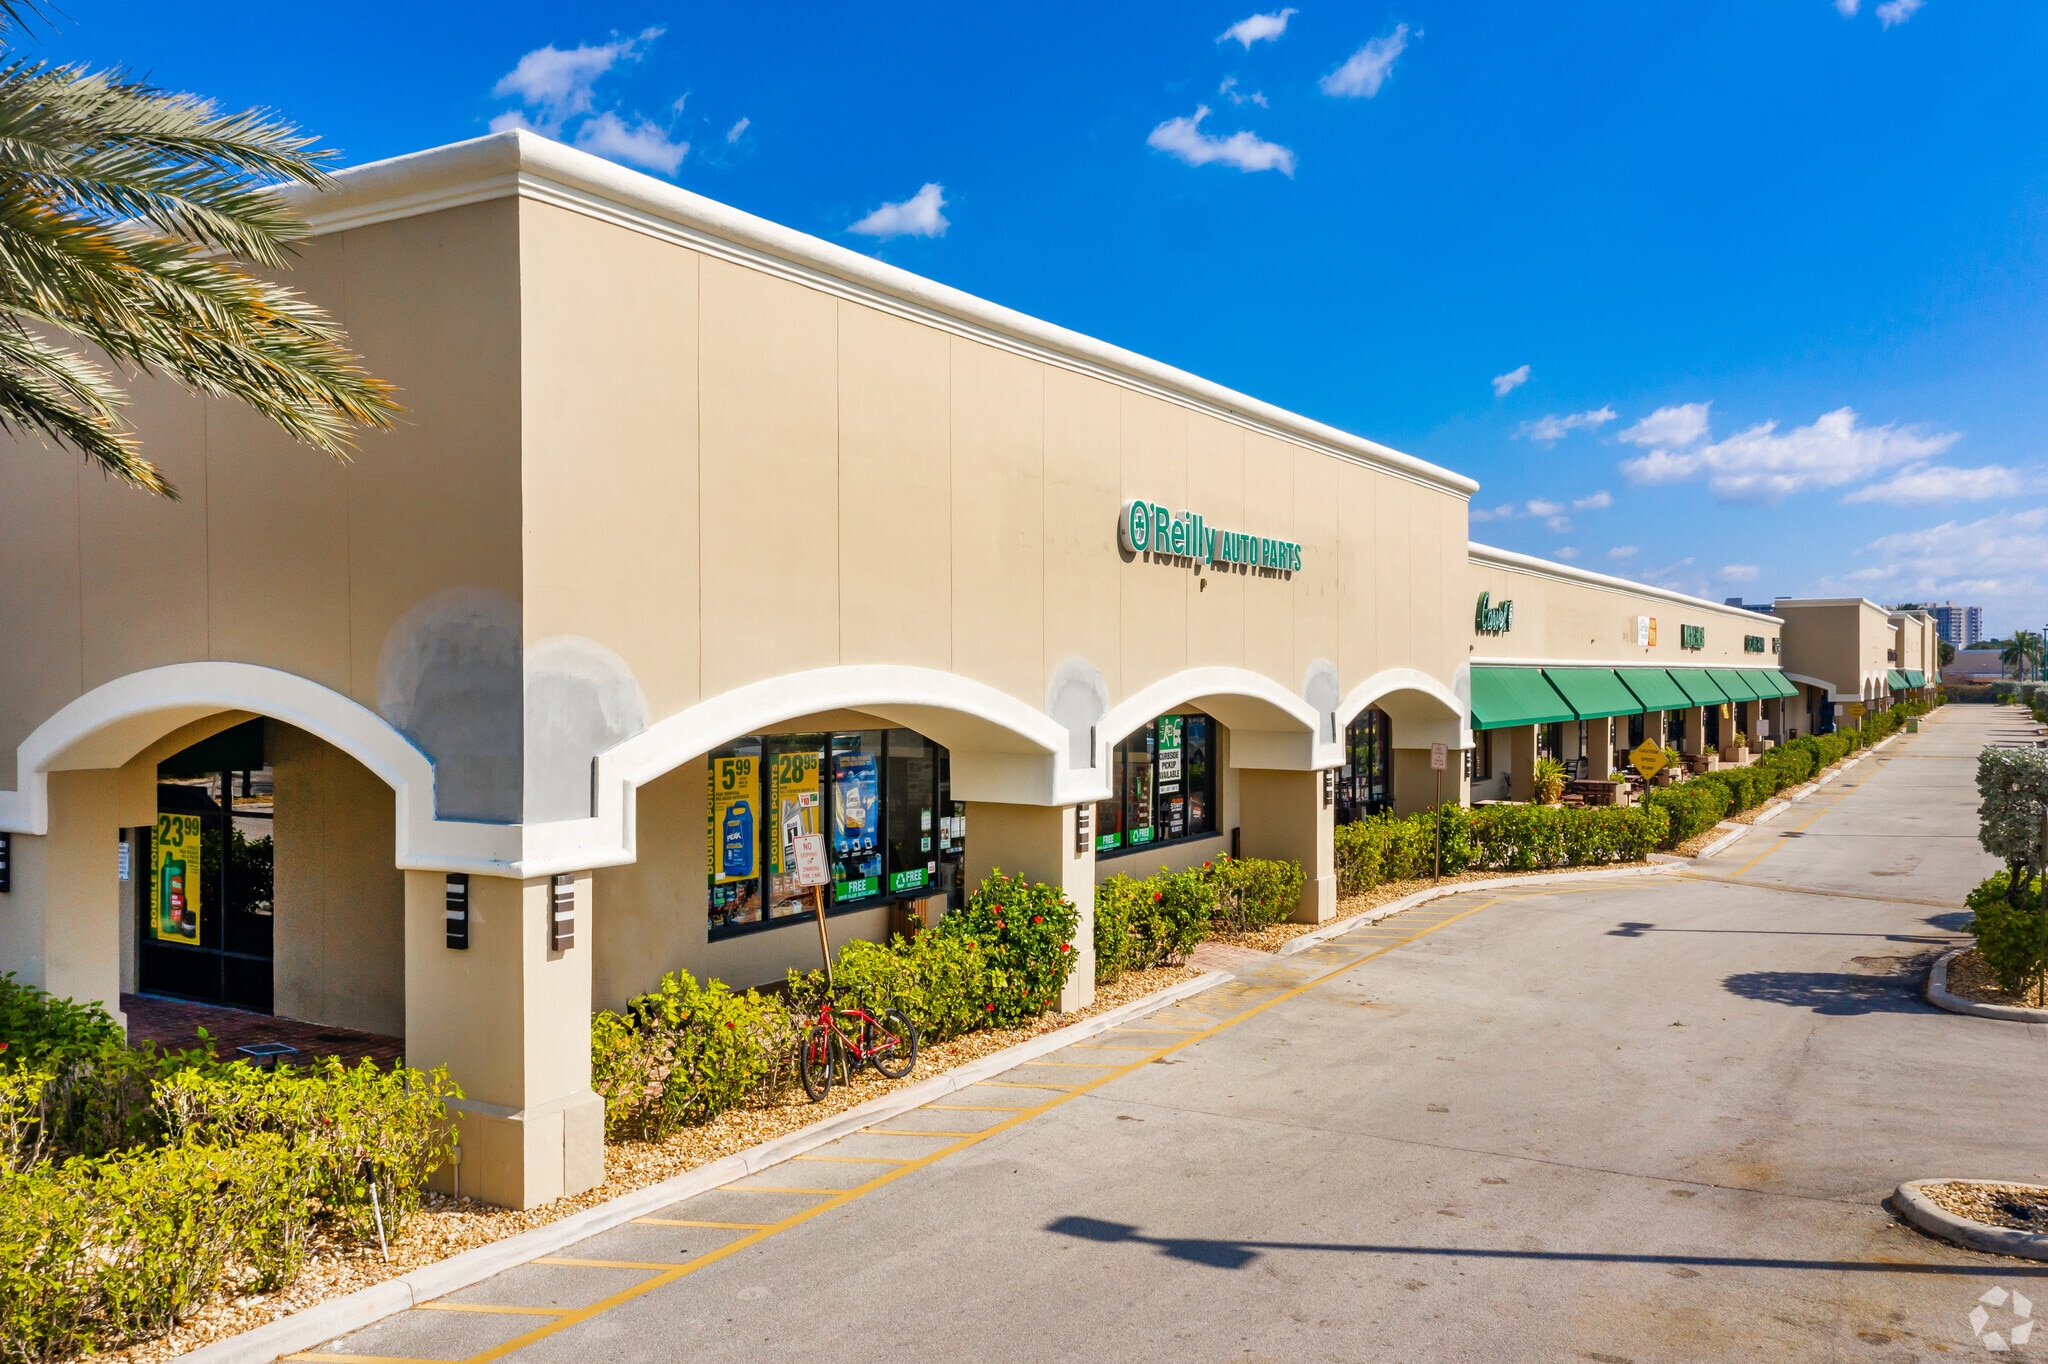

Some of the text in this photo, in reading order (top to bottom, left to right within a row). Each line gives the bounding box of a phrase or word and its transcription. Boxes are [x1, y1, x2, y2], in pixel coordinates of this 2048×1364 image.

[1130, 500, 1301, 571] O'Reilly AUTO PARTS
[1159, 751, 1179, 760] CURBSIDE
[1162, 761, 1176, 770] PICKUP
[1159, 770, 1179, 780] AVAILABLE
[1139, 828, 1149, 838] FREE
[1103, 834, 1114, 845] FREE
[803, 842, 812, 851] NO
[906, 869, 922, 881] FREE
[848, 880, 866, 893] FREE
[150, 875, 158, 929] DOUBLE
